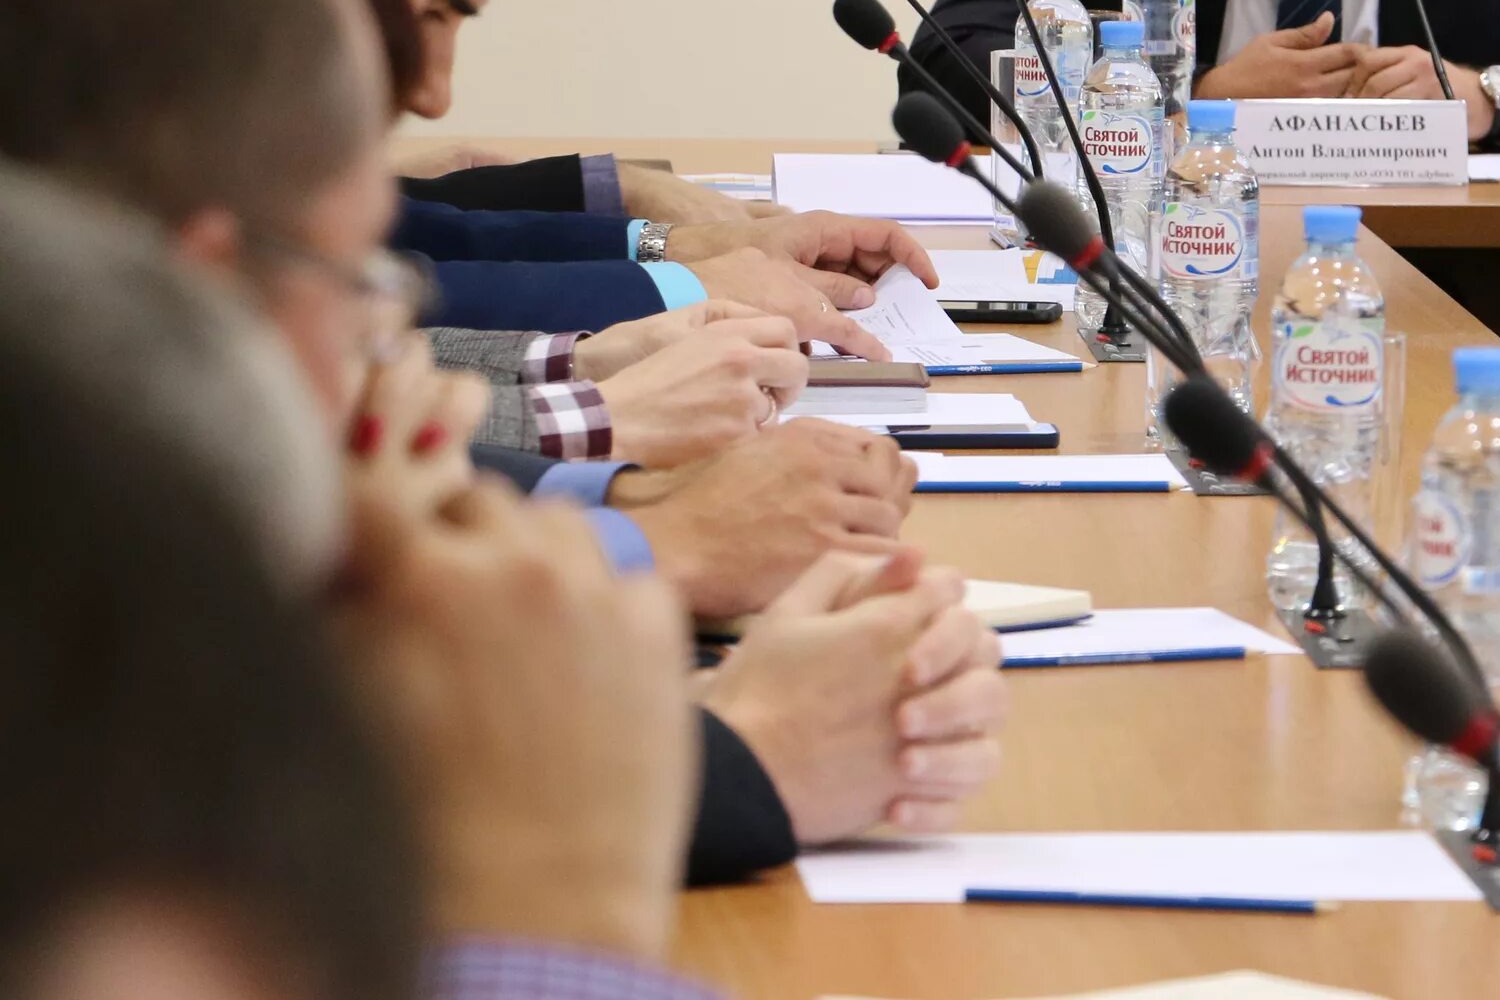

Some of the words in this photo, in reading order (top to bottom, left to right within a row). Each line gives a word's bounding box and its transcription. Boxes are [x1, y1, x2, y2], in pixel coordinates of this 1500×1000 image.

[1269, 114, 1427, 132] АФАНАСЬЕВ
[1249, 144, 1305, 159] Антон
[1312, 144, 1448, 162] Владимирович
